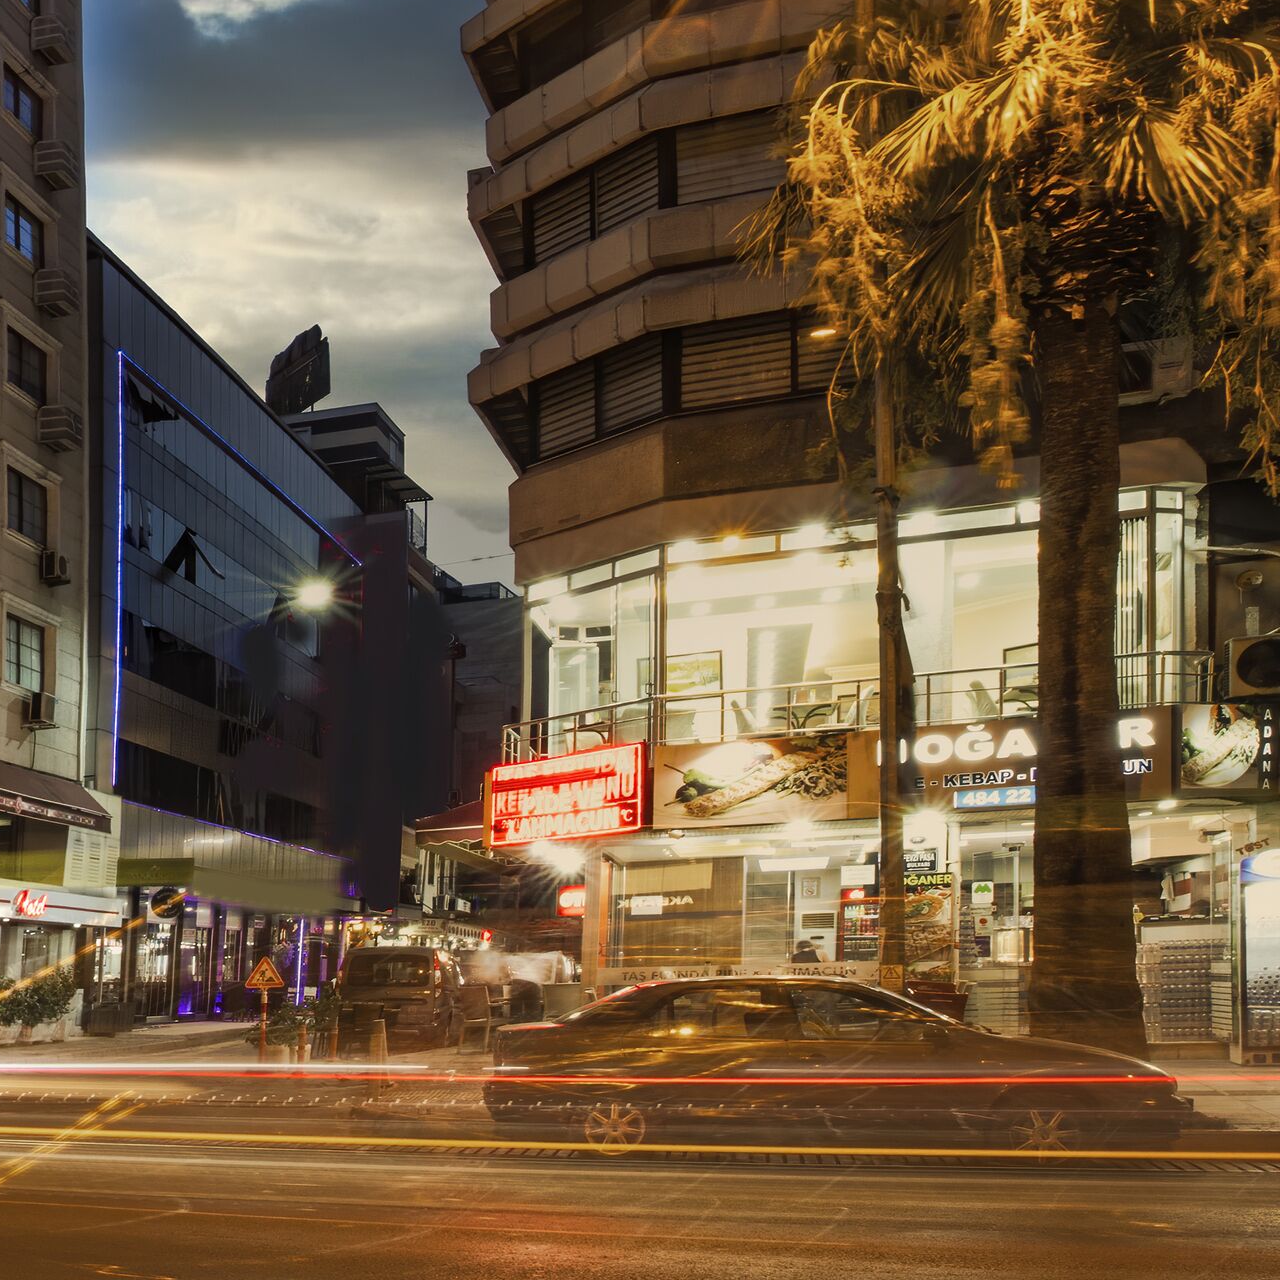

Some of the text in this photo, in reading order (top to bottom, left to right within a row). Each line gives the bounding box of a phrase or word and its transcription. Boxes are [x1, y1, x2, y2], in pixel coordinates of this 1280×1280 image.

[1262, 709, 1272, 790] ADANA
[943, 769, 1014, 788] KEBAP
[962, 788, 1031, 806] 484 22
